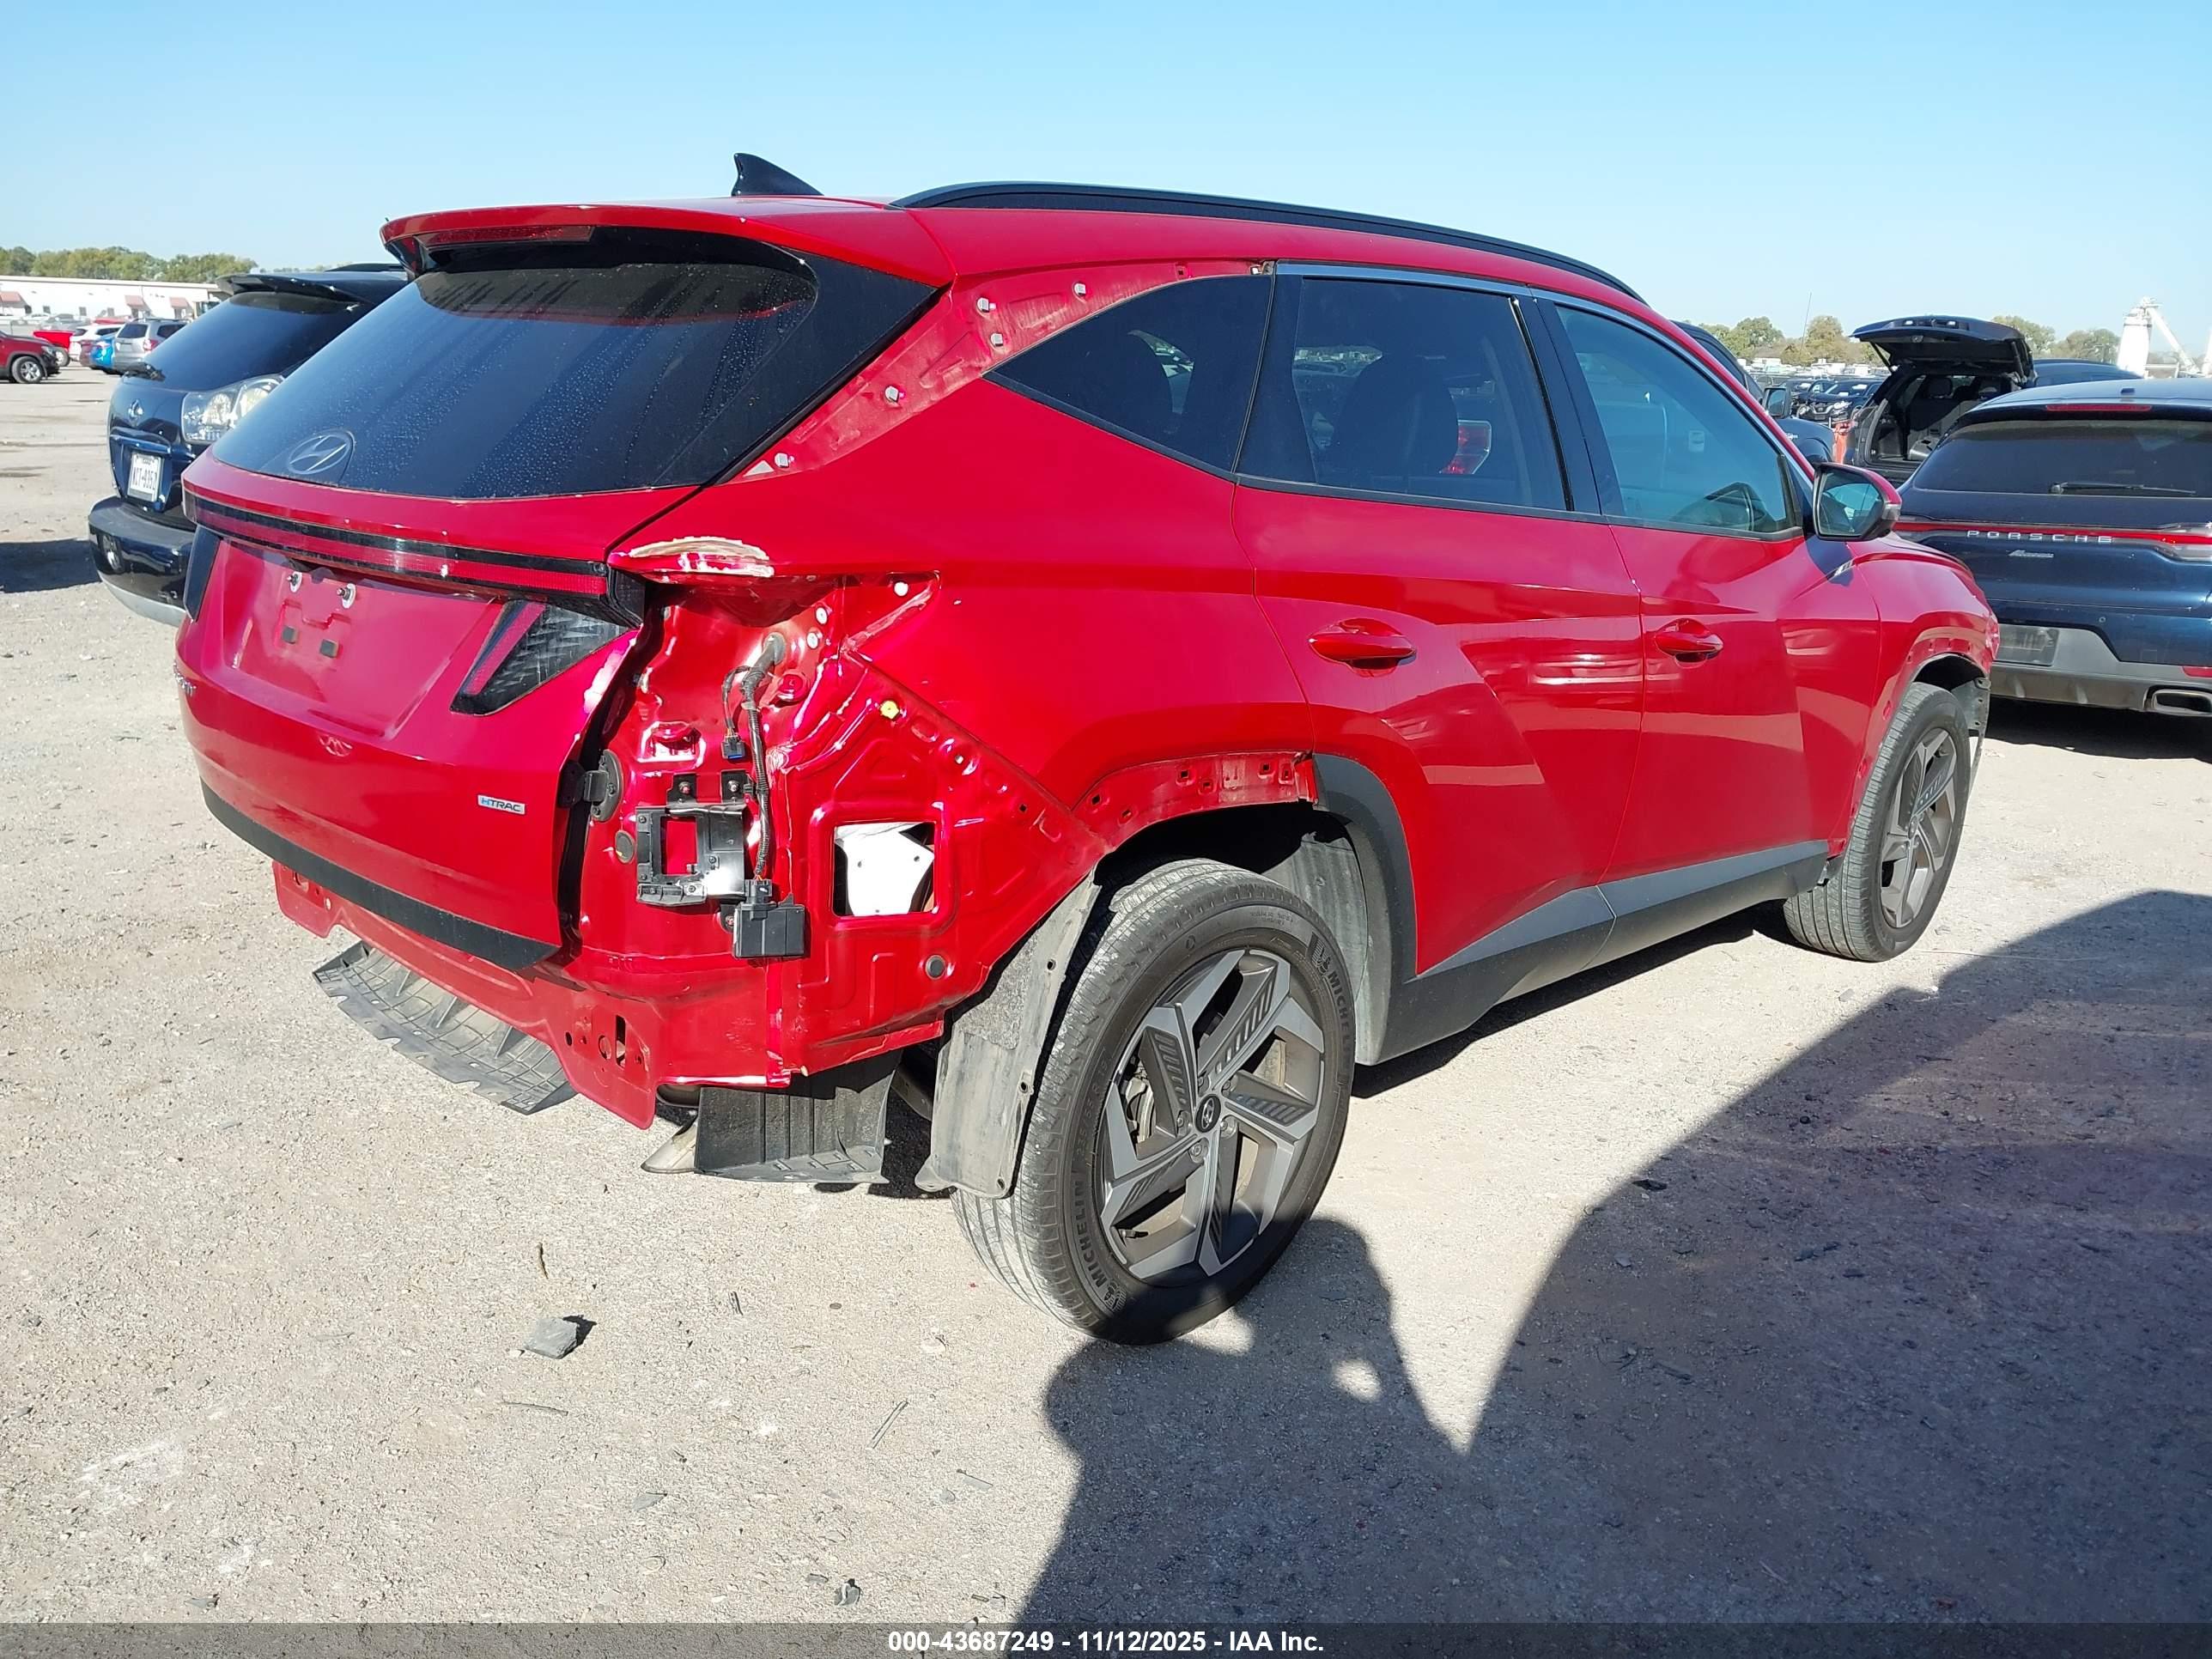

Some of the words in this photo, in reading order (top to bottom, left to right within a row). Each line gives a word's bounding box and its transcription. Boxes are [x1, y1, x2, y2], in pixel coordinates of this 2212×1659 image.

[1966, 530, 2112, 544] PORSCHE
[480, 797, 521, 812] HTRAC
[1073, 1180, 1108, 1288] MICHELIN
